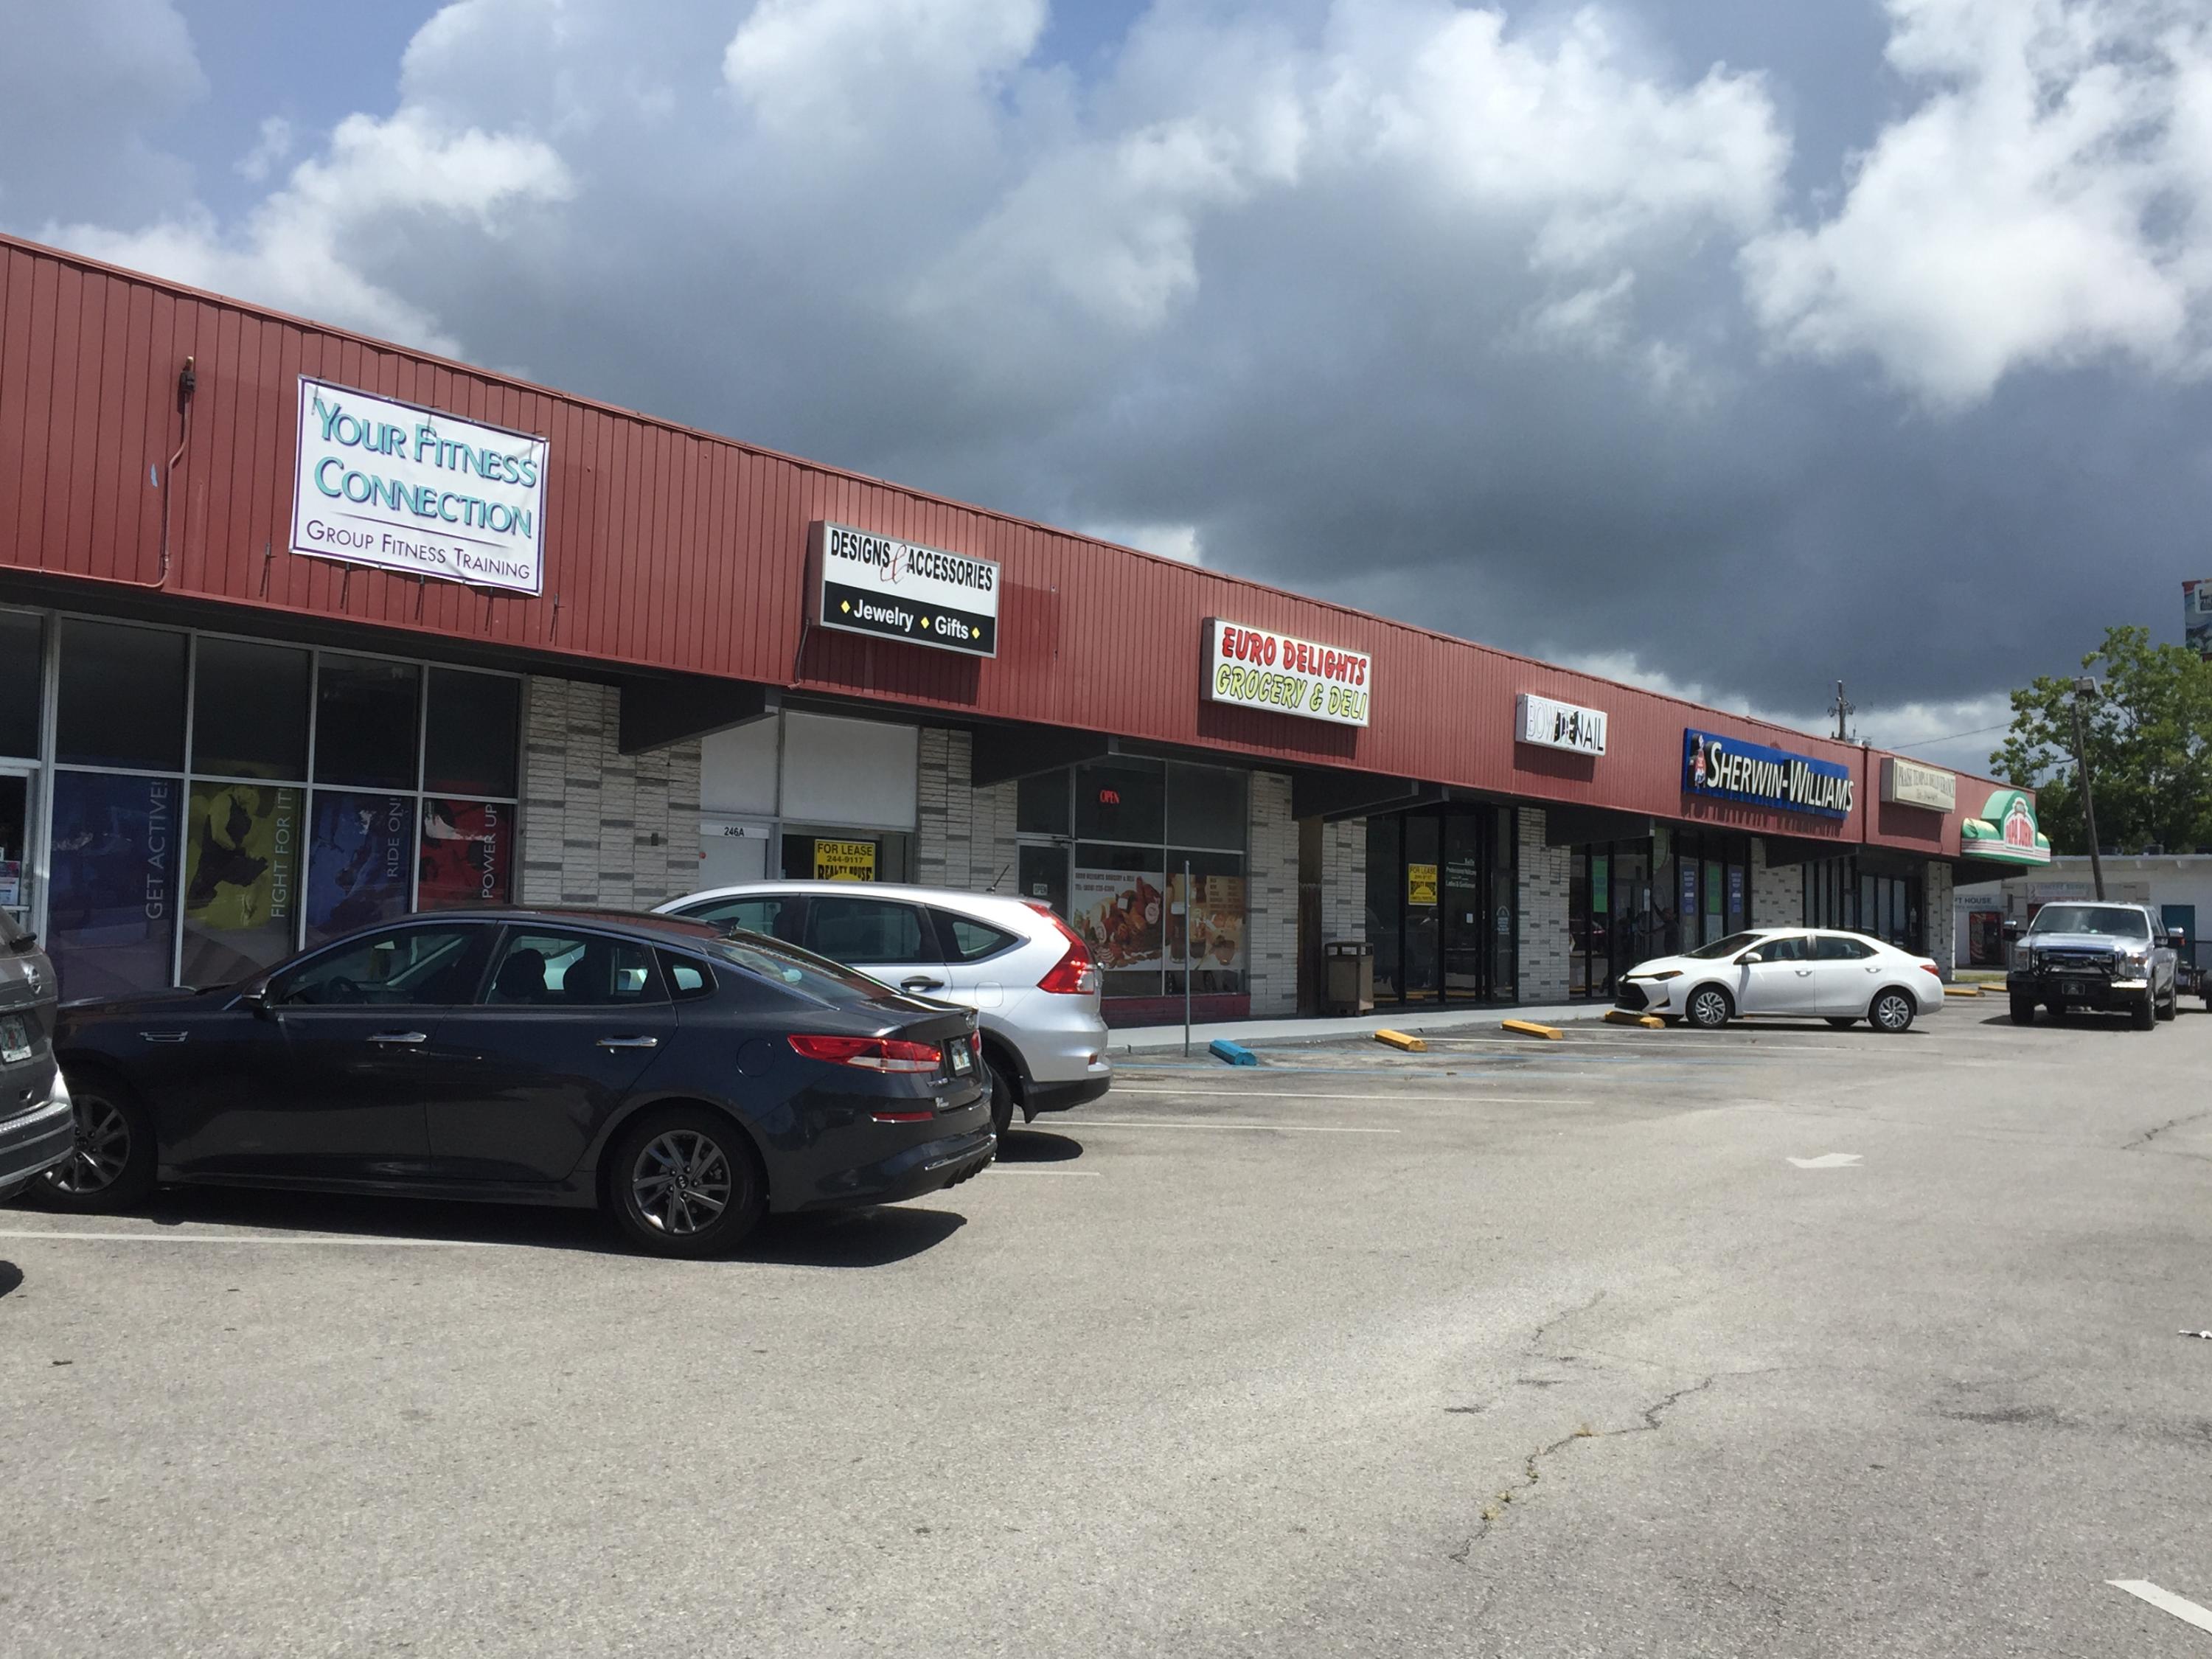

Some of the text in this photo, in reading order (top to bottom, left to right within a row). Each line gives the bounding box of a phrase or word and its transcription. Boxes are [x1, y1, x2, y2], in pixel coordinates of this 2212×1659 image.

[313, 397, 538, 487] YOUR FITNESS
[314, 456, 532, 538] CONNECTION
[307, 520, 530, 579] GROUP FITNESS TRAINING
[830, 529, 891, 568] DESIGNS
[906, 549, 992, 591] ACCESSORIES
[854, 599, 969, 639] Jewelry Gifts
[1222, 626, 1367, 686] EURO DELIGHTS
[1216, 664, 1367, 720] GROCERY & DELI
[1576, 711, 1604, 751] NAIL
[1099, 790, 1120, 804] OPEN
[1707, 742, 1854, 812] SHERWIN-WILLIAMS
[145, 781, 168, 919] GET ACTIVE!
[275, 816, 291, 854] FOR
[387, 798, 401, 877] RIDE ON!
[481, 804, 498, 898] POWER UP
[724, 827, 745, 837] 246A
[818, 844, 873, 856] FOR LEASE
[827, 855, 863, 863] 244-9117
[271, 860, 288, 917] FIGHT
[1034, 885, 1048, 894] OPEN
